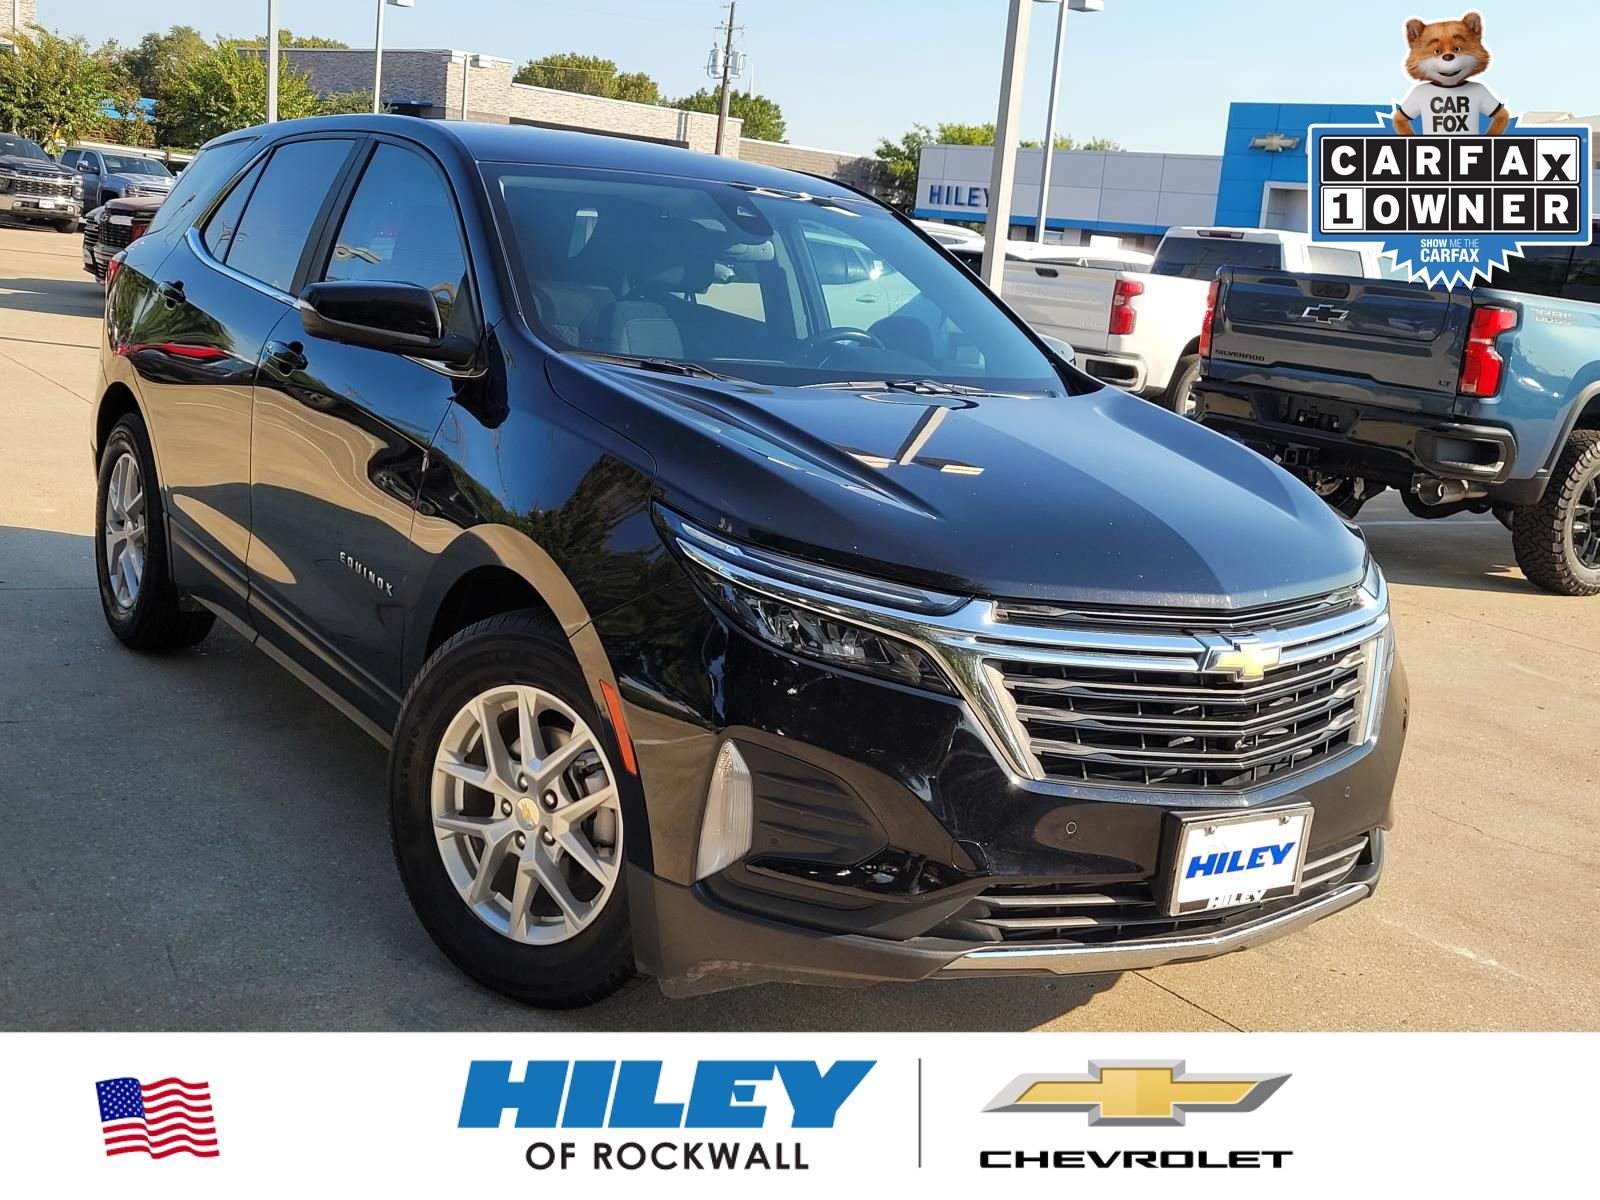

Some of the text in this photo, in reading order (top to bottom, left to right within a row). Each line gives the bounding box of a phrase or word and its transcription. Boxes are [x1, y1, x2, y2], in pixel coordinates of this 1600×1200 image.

[1214, 349, 1265, 362] SILVERADO
[1438, 379, 1452, 387] LT
[339, 551, 393, 597] EQUINOX
[1185, 841, 1296, 879] HILEY
